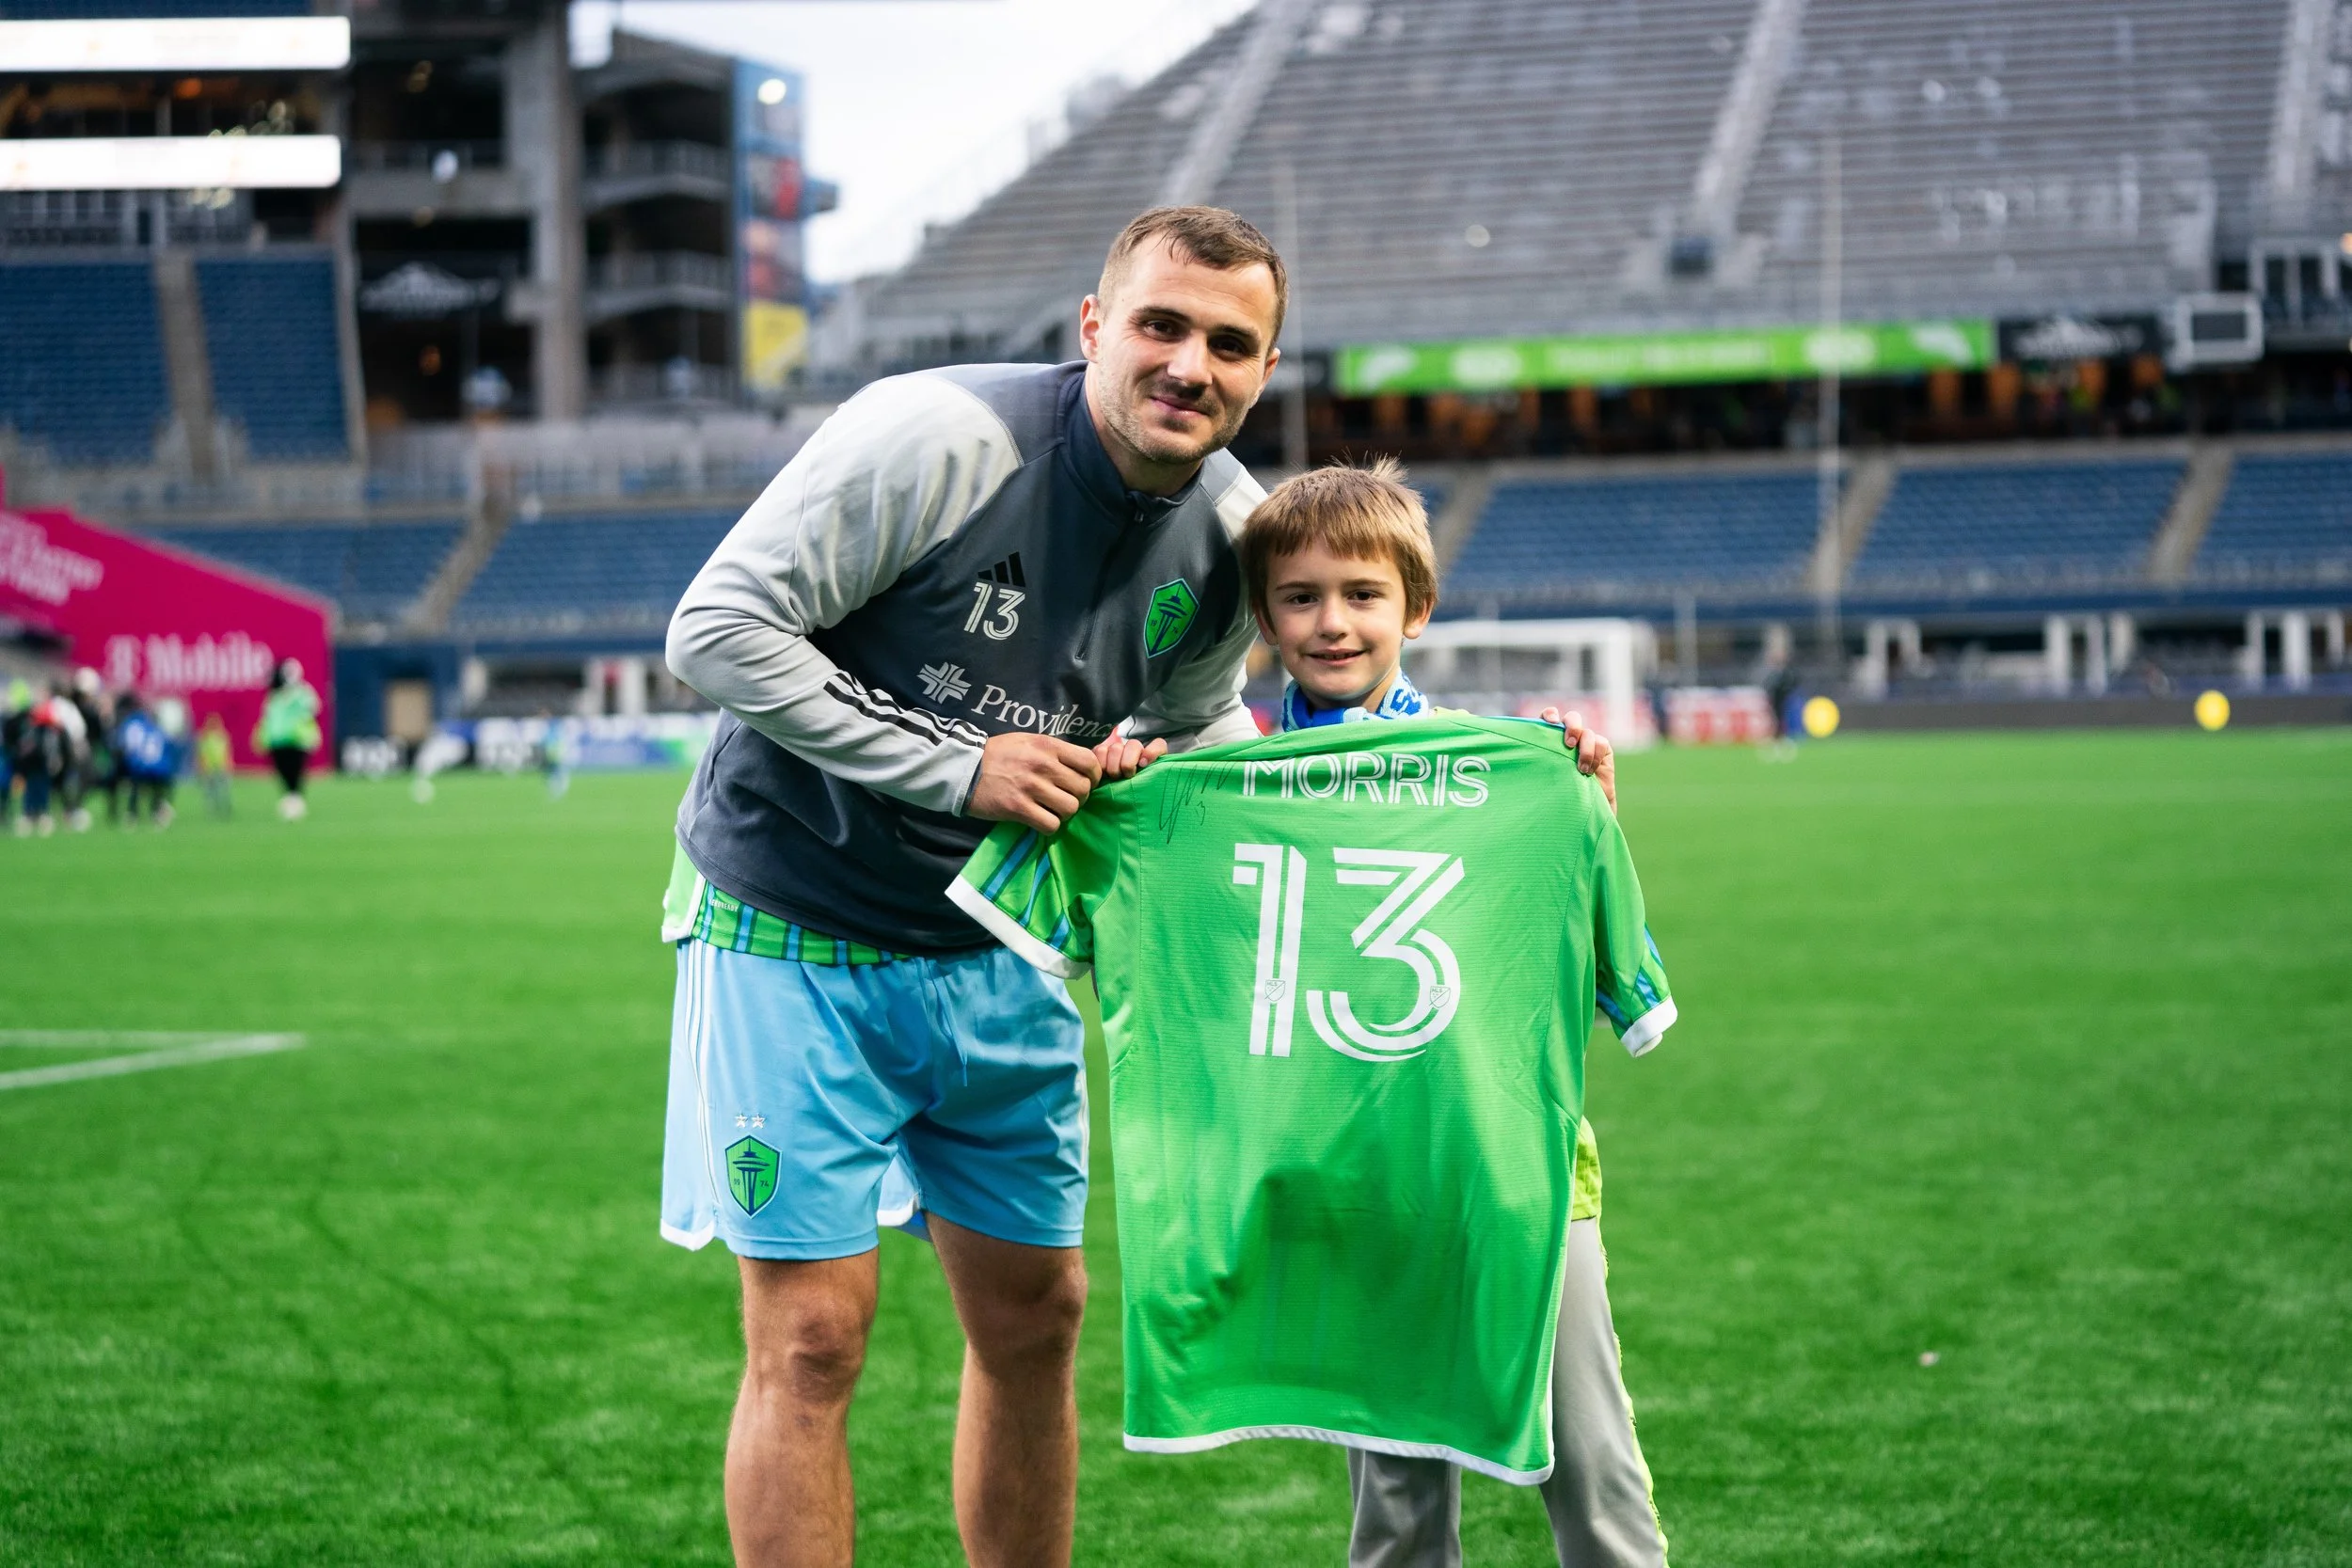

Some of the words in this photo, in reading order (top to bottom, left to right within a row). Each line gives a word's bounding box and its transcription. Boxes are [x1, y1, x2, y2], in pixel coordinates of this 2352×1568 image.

[963, 582, 1025, 641] 13
[971, 685, 1114, 736] Providenc
[1243, 752, 1491, 808] MORRIS
[1232, 843, 1466, 1062] 13
